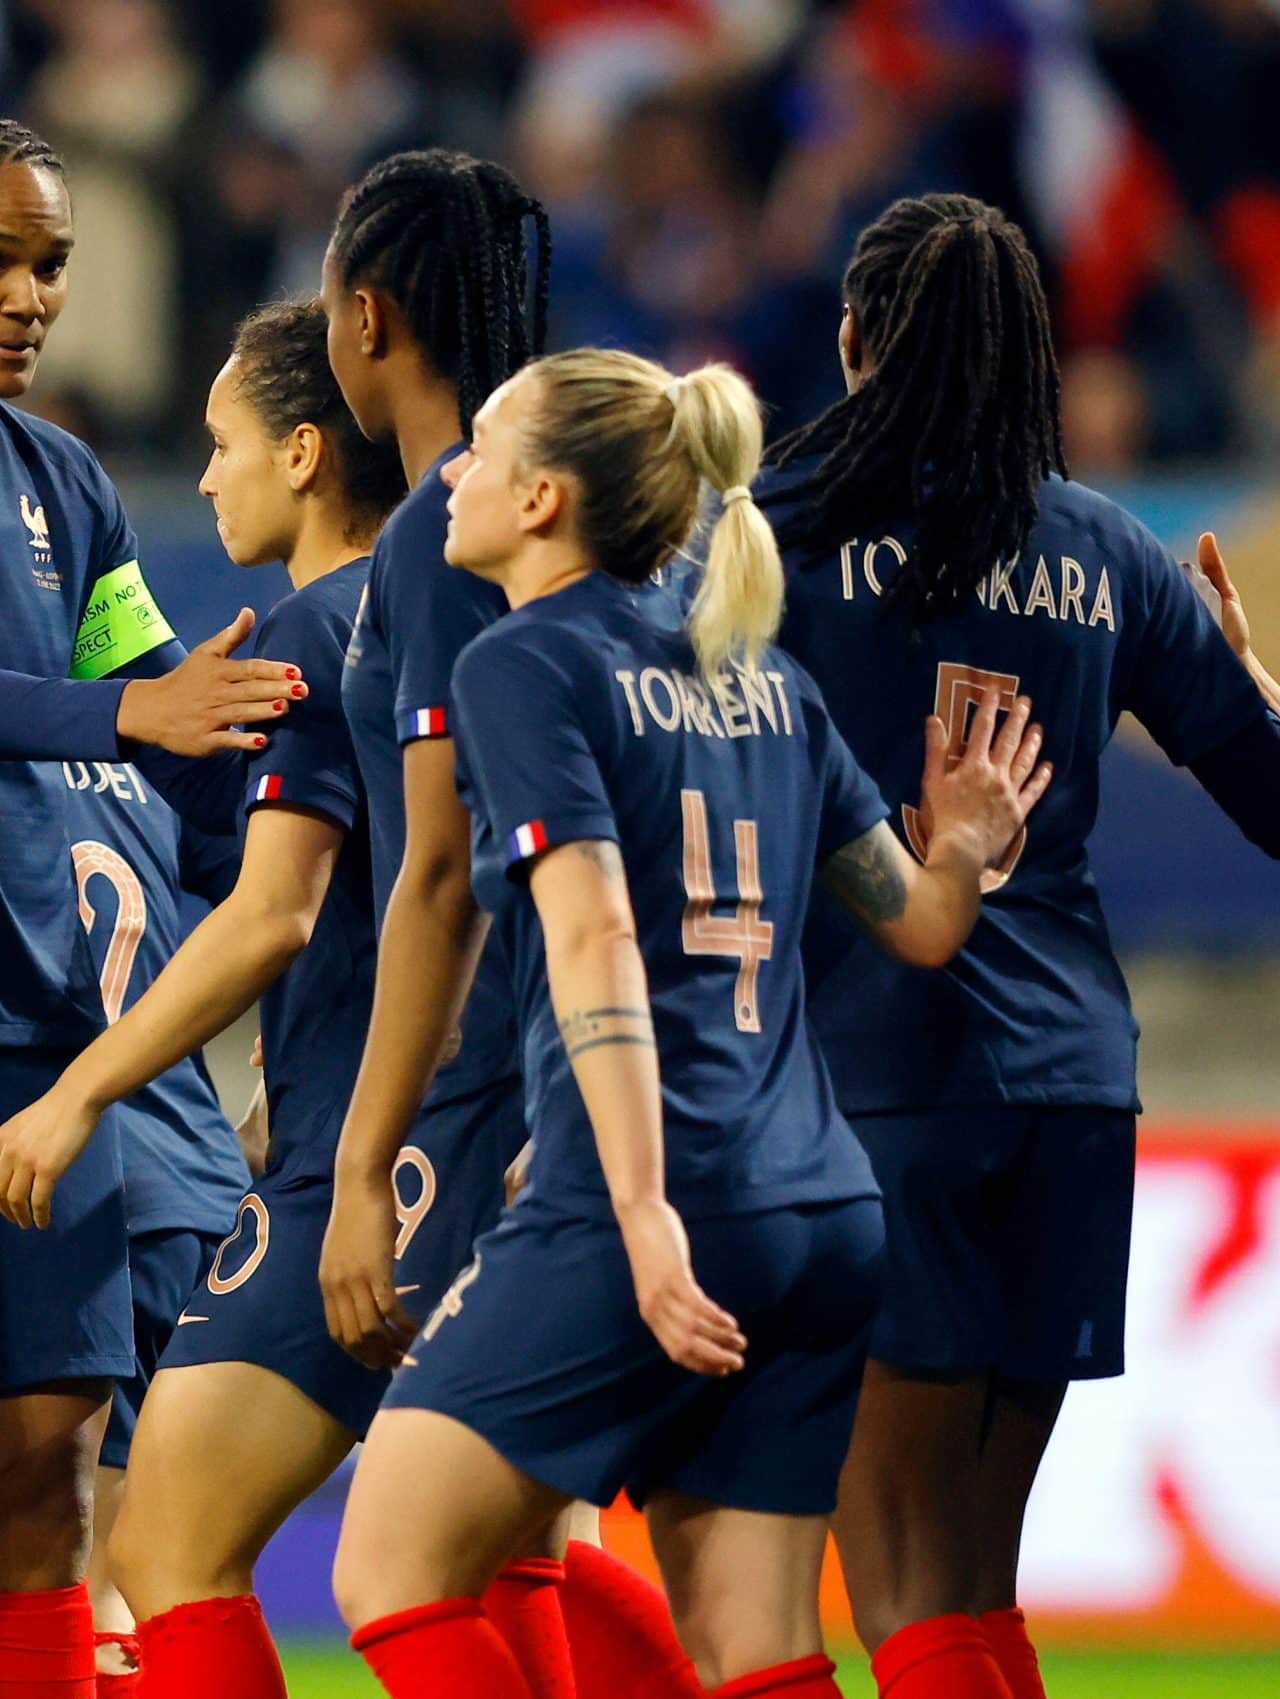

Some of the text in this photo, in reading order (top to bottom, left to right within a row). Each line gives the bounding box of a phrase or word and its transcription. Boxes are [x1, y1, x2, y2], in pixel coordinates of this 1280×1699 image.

[81, 585, 136, 627] ISM NO
[840, 535, 1115, 632] TOKARA
[615, 667, 792, 739] TORRENT
[681, 789, 773, 1033] 4
